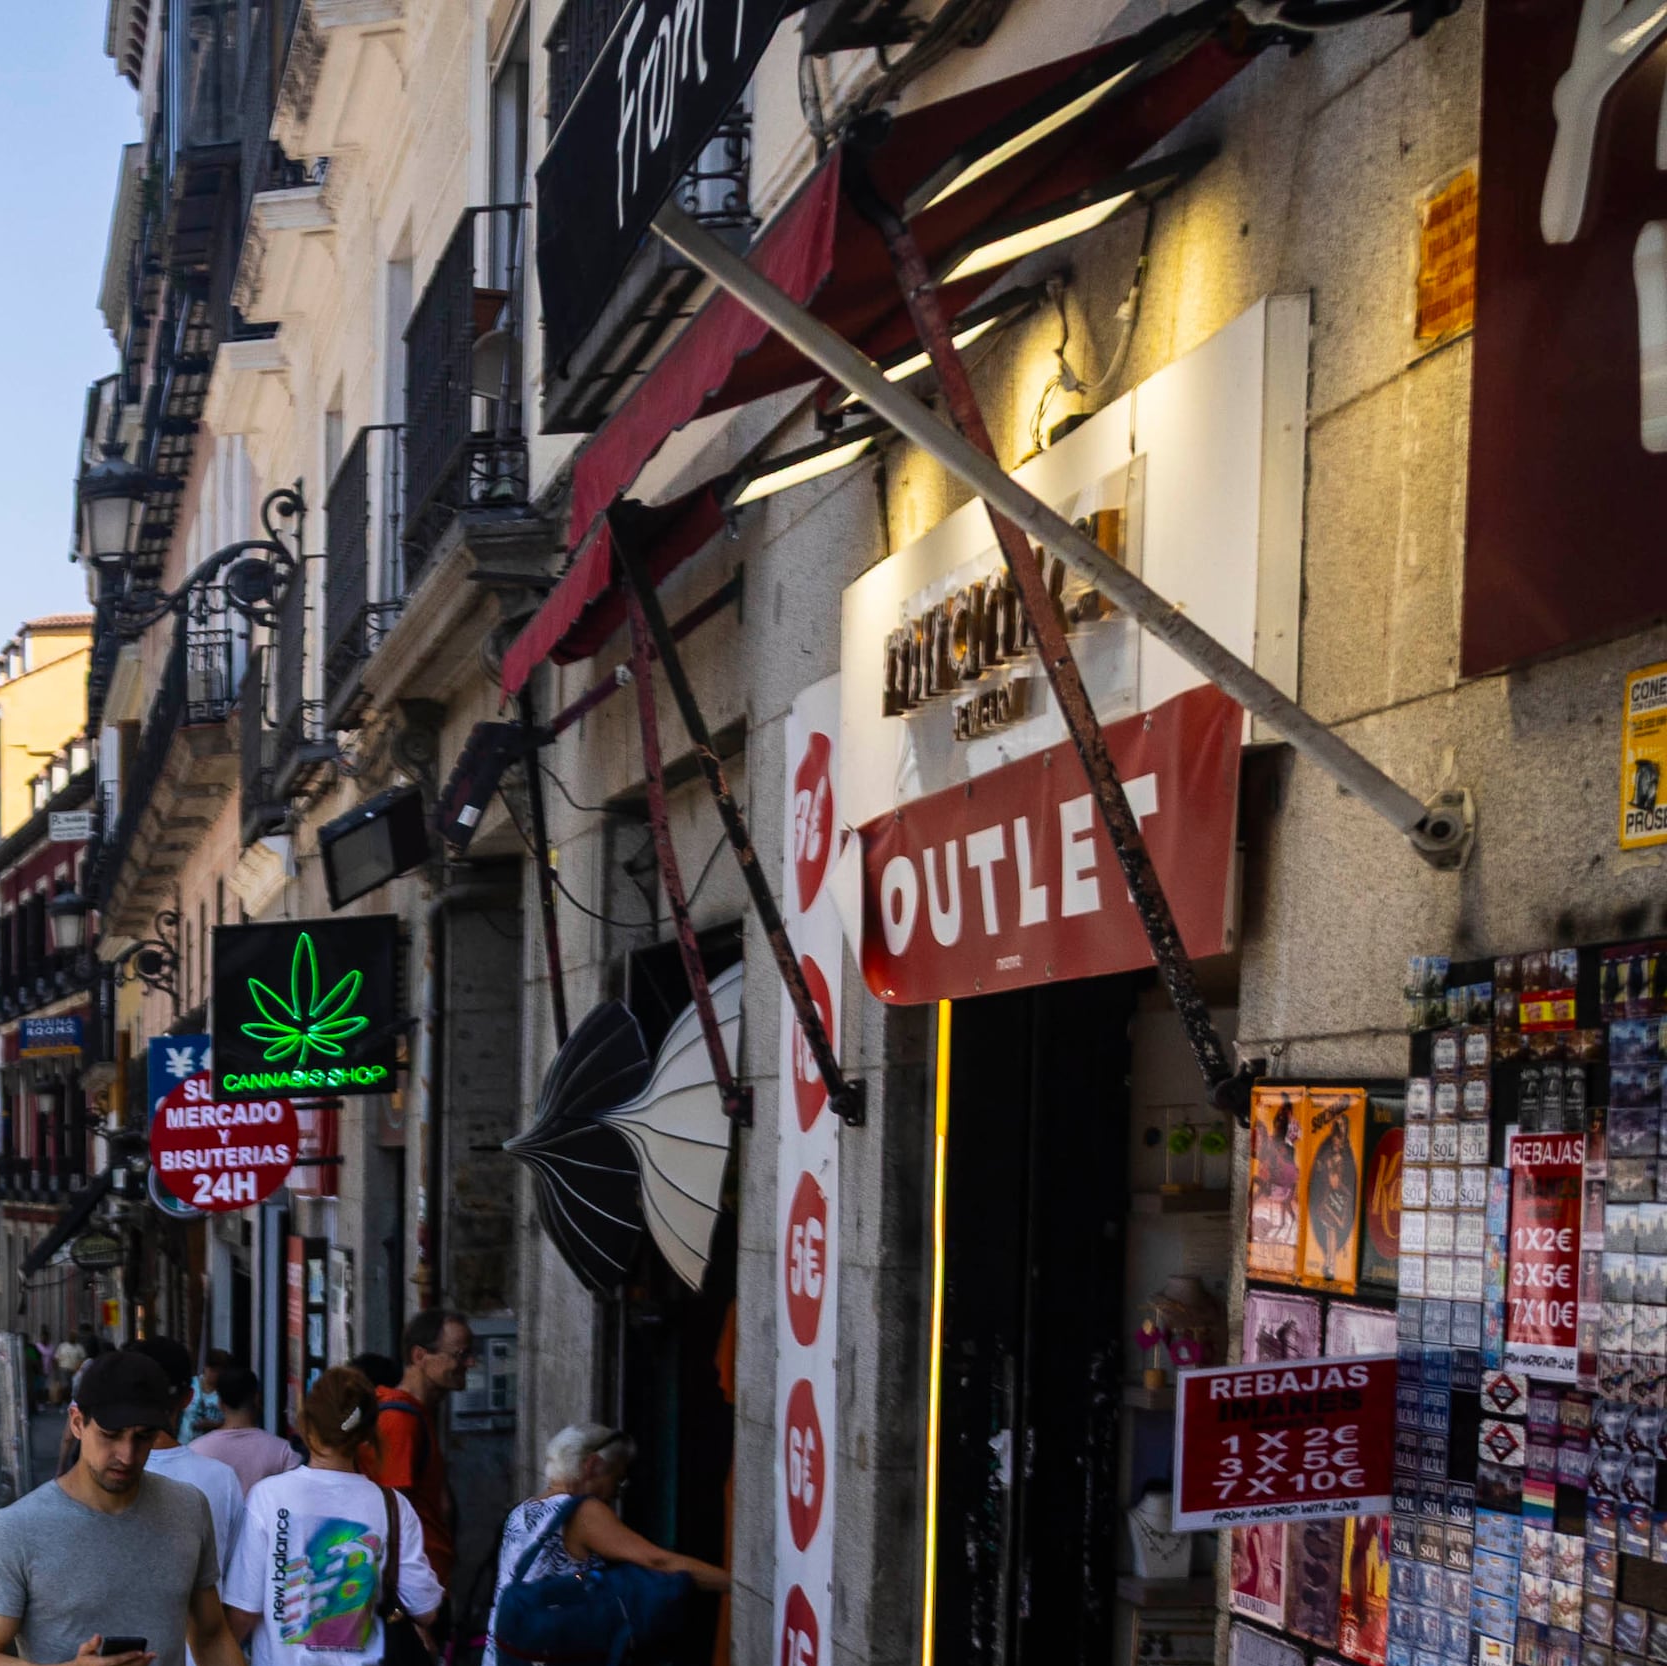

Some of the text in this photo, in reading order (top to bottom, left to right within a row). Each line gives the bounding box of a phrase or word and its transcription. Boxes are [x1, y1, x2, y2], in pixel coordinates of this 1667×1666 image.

[223, 1065, 388, 1092] CANNABIS SHOP
[166, 1101, 283, 1129] MERCADO
[217, 1129, 232, 1145] Y
[1433, 1143, 1455, 1157] SOL
[1461, 1142, 1485, 1156] SOL
[160, 1144, 290, 1170] BISUTERIAS
[1405, 1143, 1426, 1158] SOL
[1511, 1139, 1584, 1166] REBAJAS
[192, 1171, 258, 1204] 24H
[1404, 1187, 1424, 1201] SOL
[1432, 1188, 1453, 1202] SOL
[1460, 1188, 1482, 1202] SOL
[790, 1216, 824, 1300] 5€
[1210, 1365, 1370, 1400] REBAJAS
[1218, 1390, 1362, 1421] IMANES
[1221, 1424, 1359, 1454] 1 X 2€
[789, 1426, 815, 1508] 6€
[1218, 1447, 1360, 1478] 3 X 5€
[1211, 1468, 1366, 1500] 7 X 10€
[1395, 1496, 1415, 1512] SOL
[1422, 1500, 1443, 1516] SOL
[1450, 1505, 1472, 1521] SOL
[272, 1508, 289, 1582] balance
[1393, 1539, 1412, 1554] SOL
[1420, 1544, 1440, 1560] SOL
[1448, 1550, 1469, 1567] SOL
[273, 1584, 285, 1621] new
